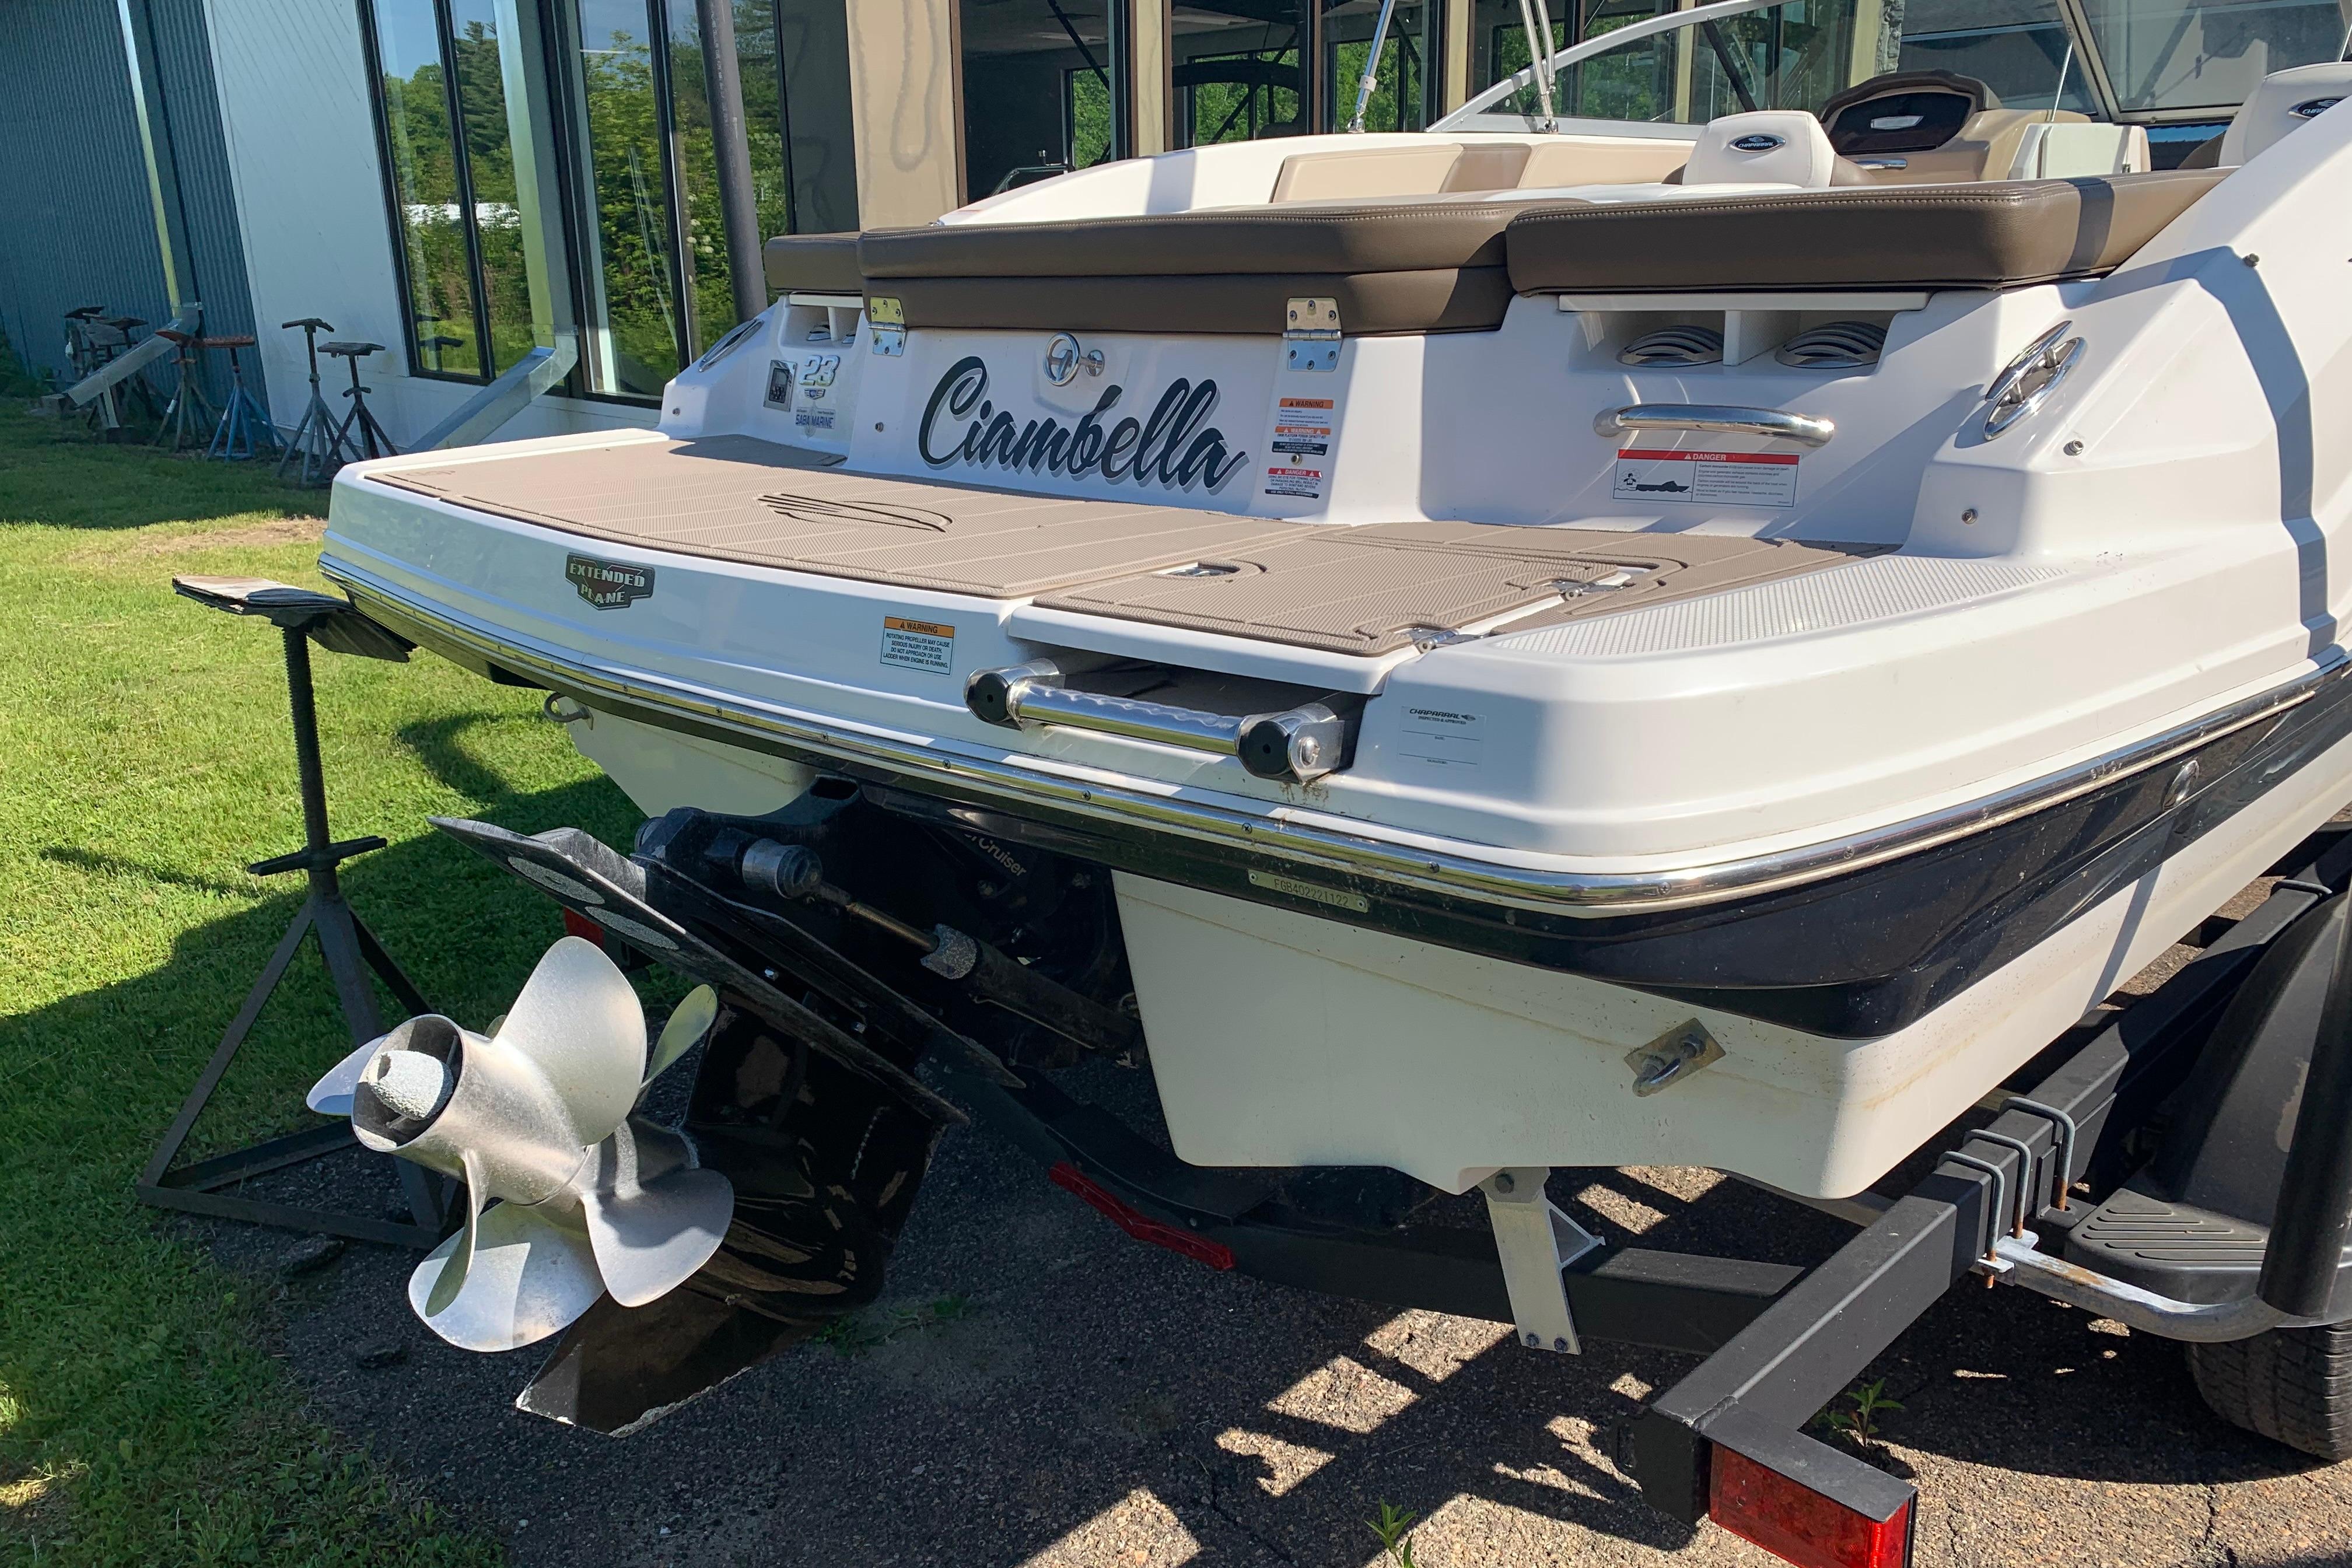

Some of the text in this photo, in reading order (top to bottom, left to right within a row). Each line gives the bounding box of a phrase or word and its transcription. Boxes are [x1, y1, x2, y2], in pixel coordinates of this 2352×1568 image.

[799, 355, 840, 386] 23
[811, 414, 834, 429] MARINE
[918, 356, 1249, 495] Ciambella
[569, 563, 645, 587] EXTENDED
[581, 583, 625, 604] PLANE
[907, 622, 938, 634] WARNING
[905, 635, 928, 643] PROPELLER
[905, 649, 926, 657] APPROACH
[930, 660, 949, 668] RUNNING.
[1409, 708, 1461, 719] CHAPARRAL
